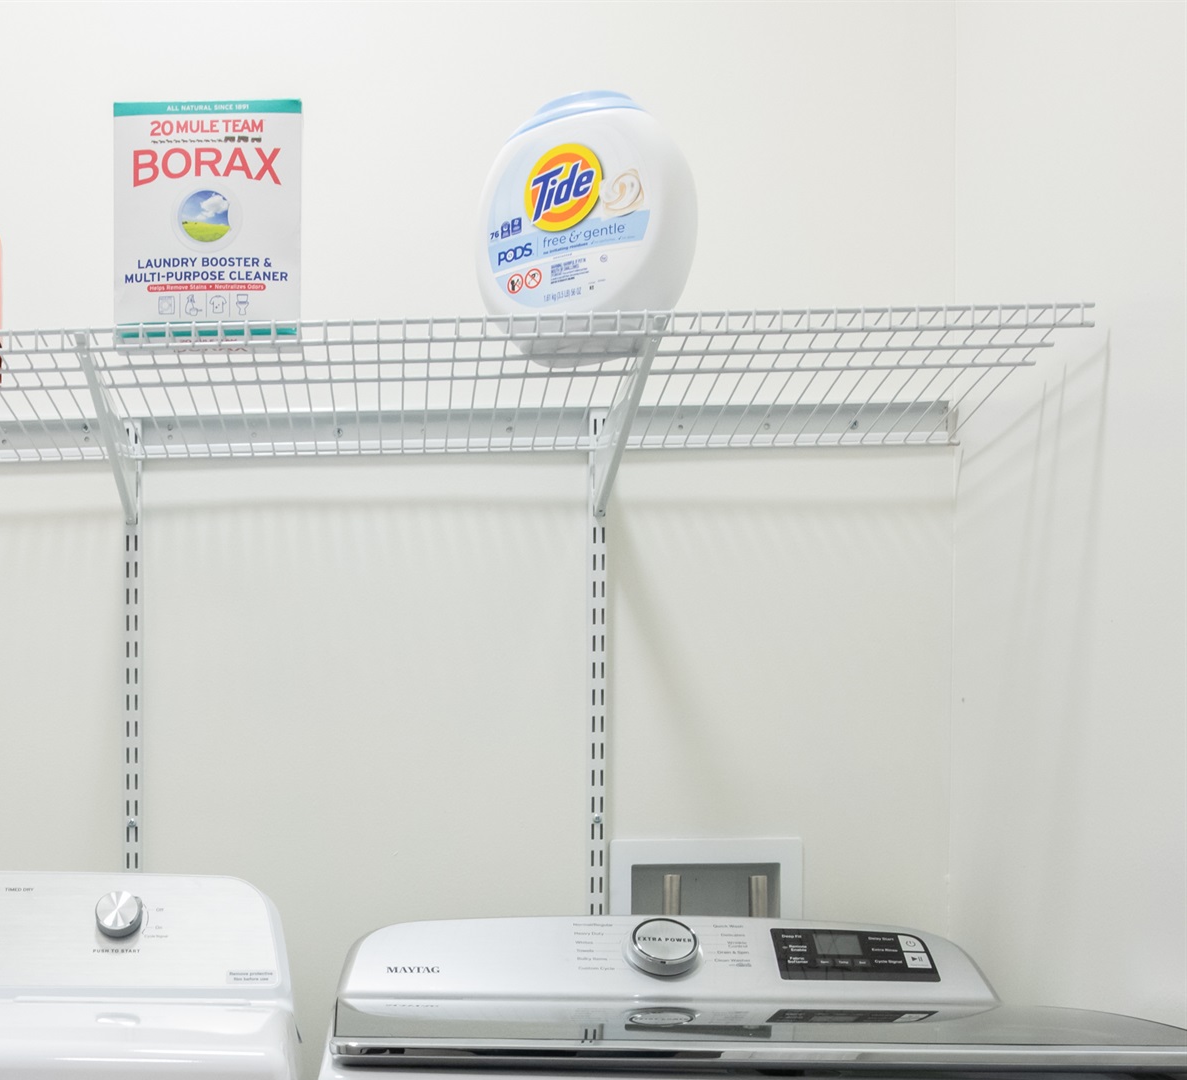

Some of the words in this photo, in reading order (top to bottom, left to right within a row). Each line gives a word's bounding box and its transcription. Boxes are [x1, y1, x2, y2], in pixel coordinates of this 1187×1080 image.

[150, 120, 173, 136] 20
[176, 120, 219, 134] MULE
[222, 119, 263, 133] TEAM
[133, 147, 282, 187] BORAX
[531, 160, 595, 223] Tide
[490, 231, 499, 240] 76
[543, 235, 566, 248] free
[569, 230, 582, 243] &
[583, 223, 625, 241] gentle
[137, 257, 197, 269] LAUNDRY
[202, 257, 260, 268] BOOSTER
[263, 257, 272, 267] &
[498, 242, 533, 266] PODS
[124, 271, 225, 284] MULTI-PURPOSE
[229, 271, 288, 281] CLEANER
